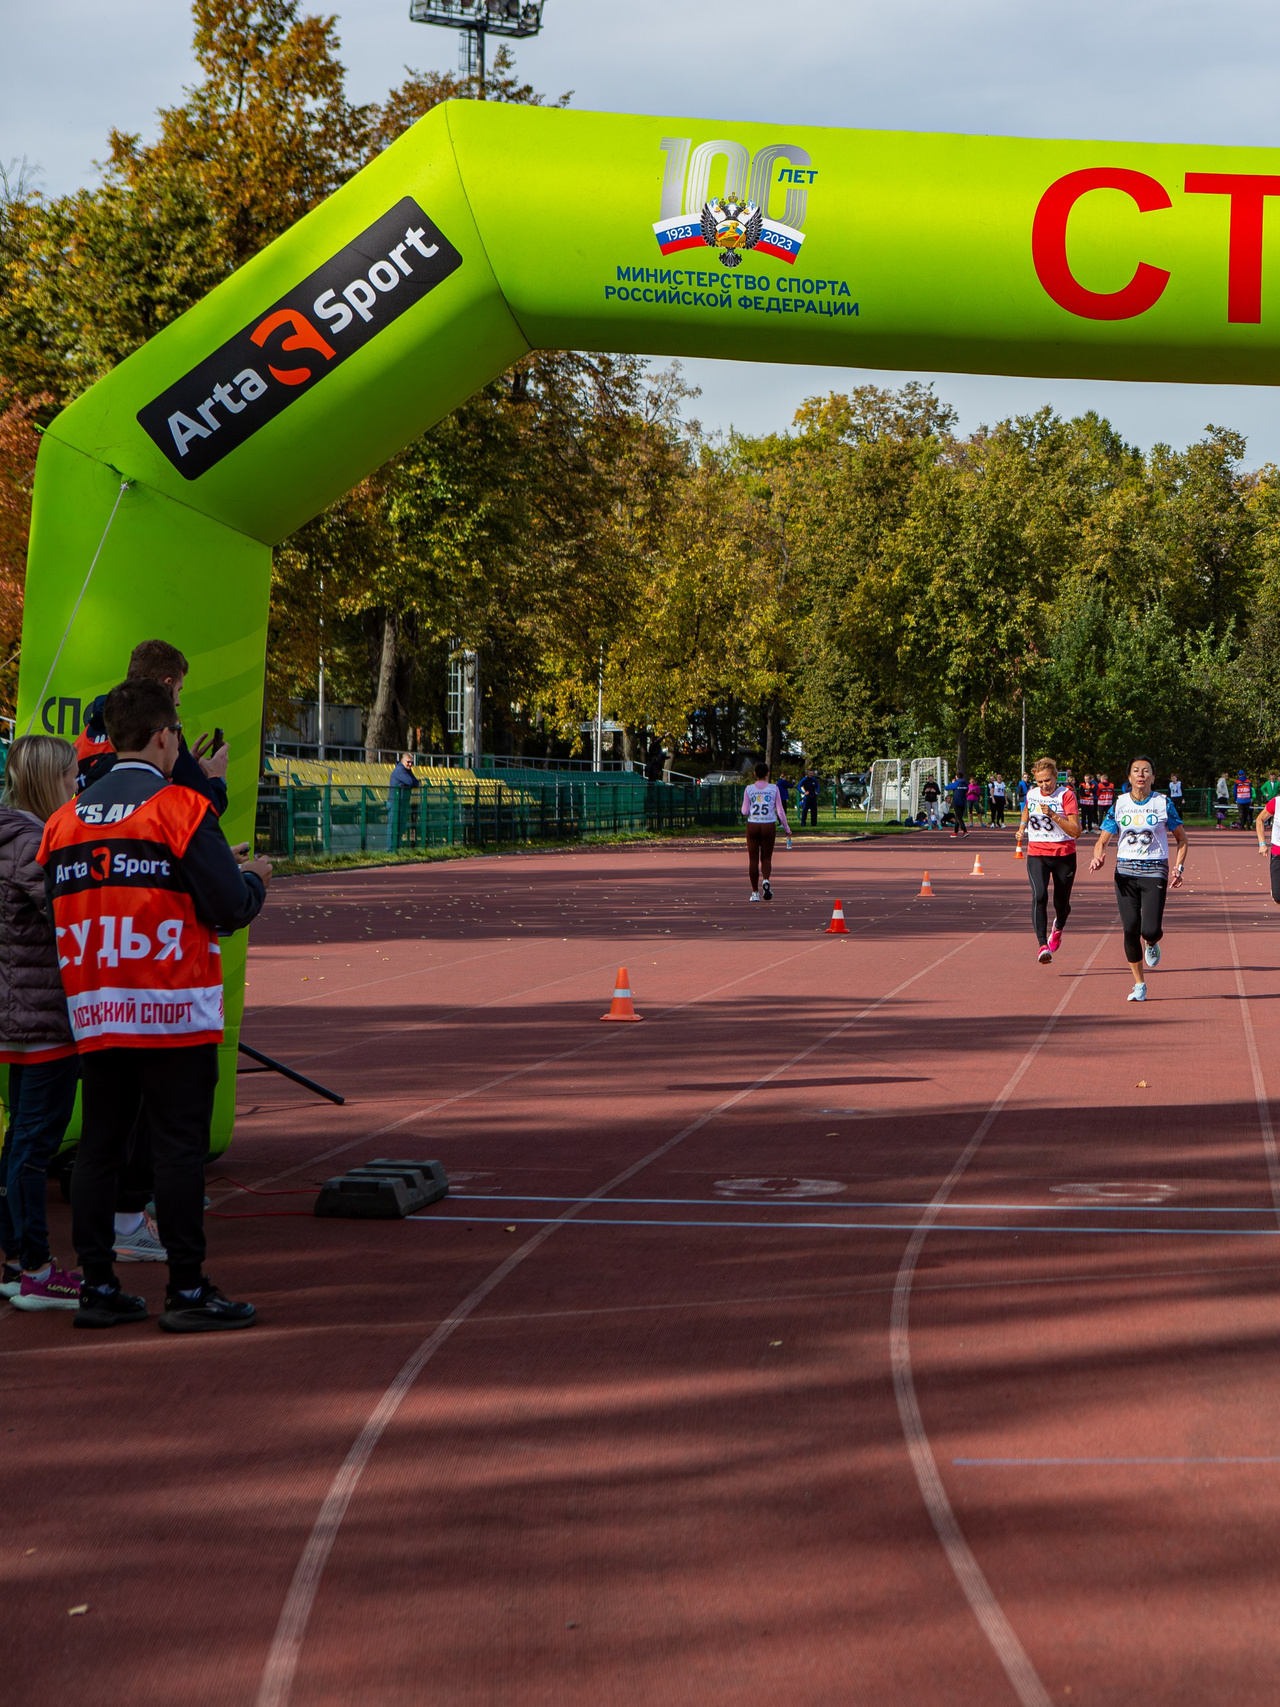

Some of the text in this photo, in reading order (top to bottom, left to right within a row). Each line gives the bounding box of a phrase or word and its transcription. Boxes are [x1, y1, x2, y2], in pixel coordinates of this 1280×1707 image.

[777, 168, 818, 184] ЛЕТ
[665, 226, 693, 242] 1923
[763, 231, 793, 251] 2023
[616, 265, 851, 297] МИНИСТЕРСТВО СПОРТА
[604, 285, 860, 317] РОССИЙСКОЙ ФЕДЕРАЦИИ
[167, 226, 440, 457] Arta Sport
[752, 804, 769, 815] 25
[1030, 816, 1054, 831] 83
[1126, 829, 1153, 845] 33
[55, 853, 171, 885] Arta Sport
[140, 1002, 193, 1024] СПОРТ
